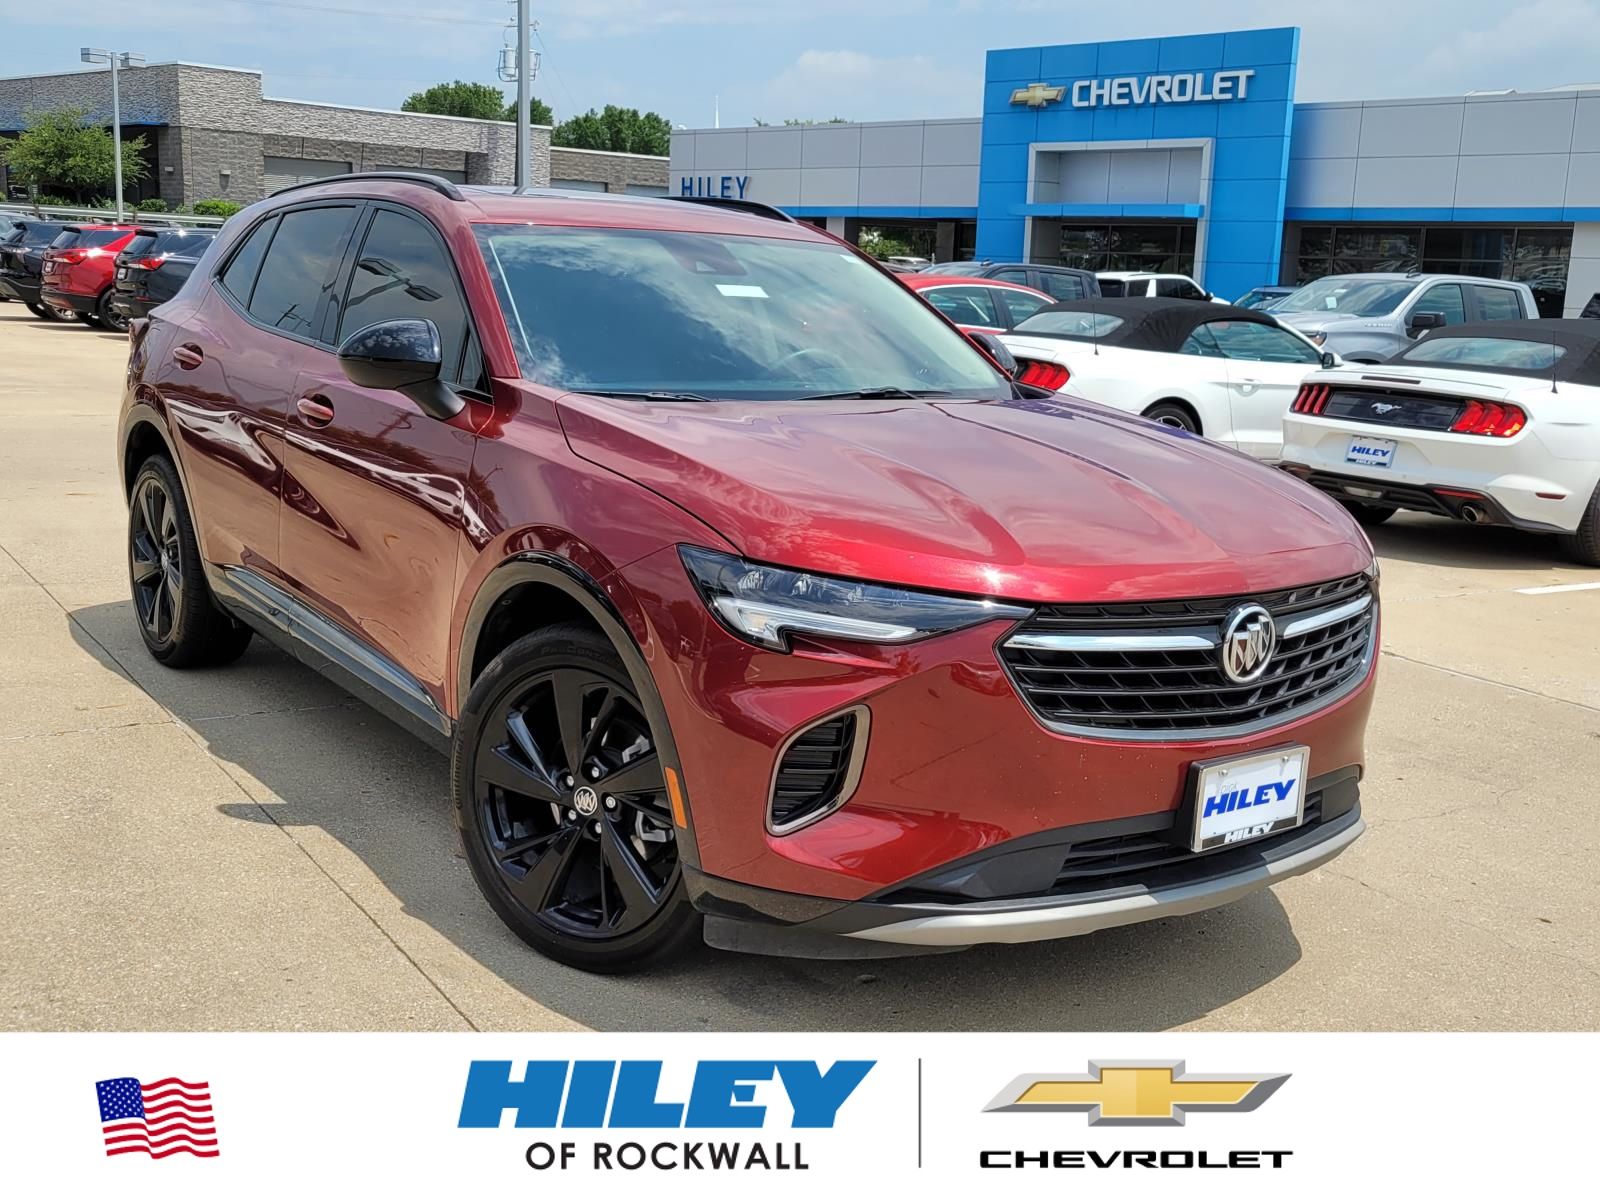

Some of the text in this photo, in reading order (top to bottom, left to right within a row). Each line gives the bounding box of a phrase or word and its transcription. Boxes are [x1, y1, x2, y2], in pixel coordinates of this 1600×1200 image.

[1072, 69, 1255, 108] CHEVROLET
[681, 175, 748, 199] HILEY
[1351, 446, 1390, 457] HILEY
[1203, 779, 1296, 818] HILEY
[1224, 821, 1275, 844] HILEY
